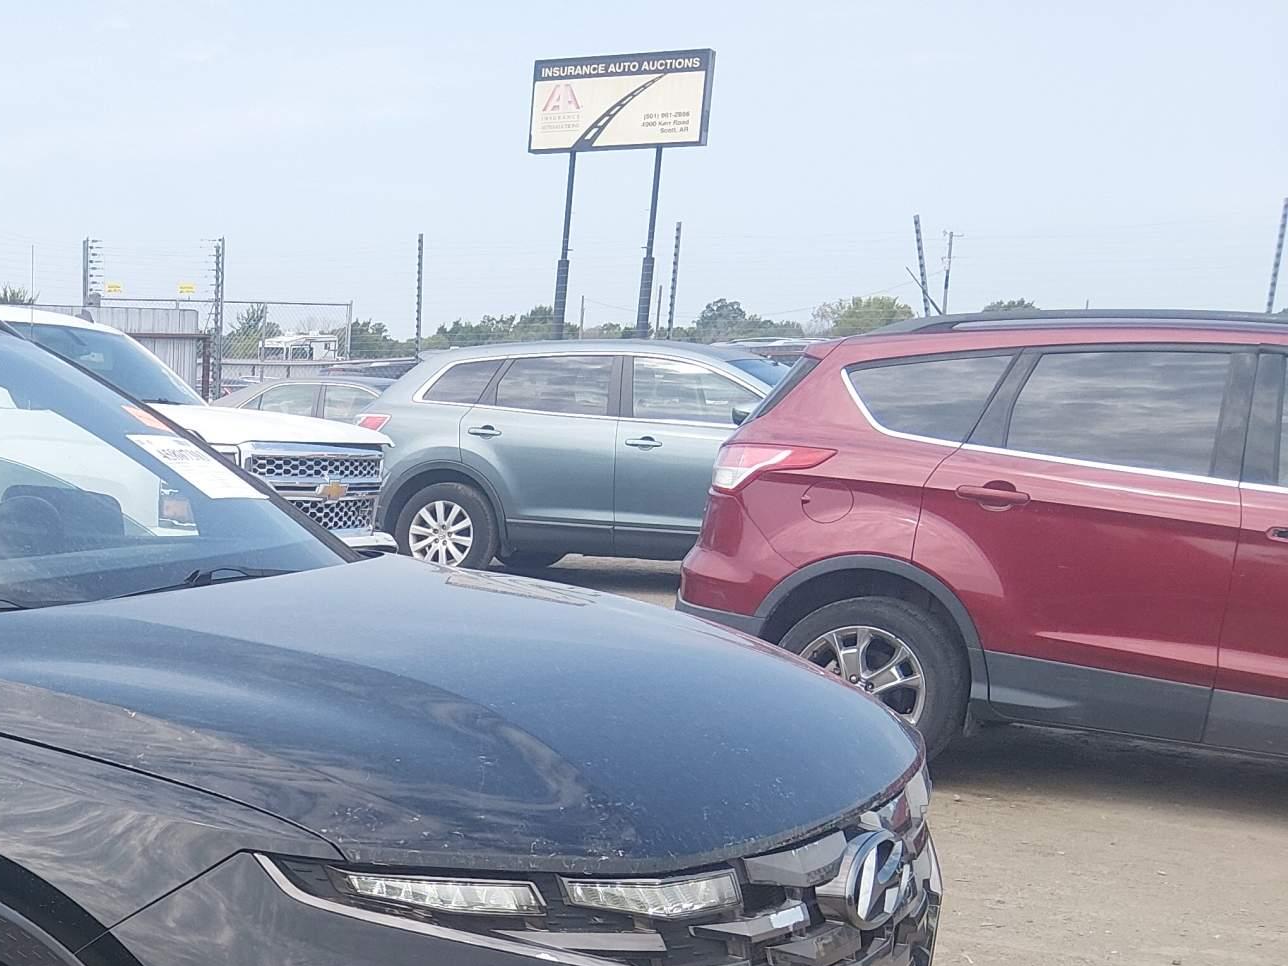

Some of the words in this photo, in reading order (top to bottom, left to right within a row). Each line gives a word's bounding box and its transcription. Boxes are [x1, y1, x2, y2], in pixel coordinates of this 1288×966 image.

[541, 63, 606, 78] INSURANCE
[608, 61, 639, 73] AUTO
[641, 57, 701, 71] AUCTIONS
